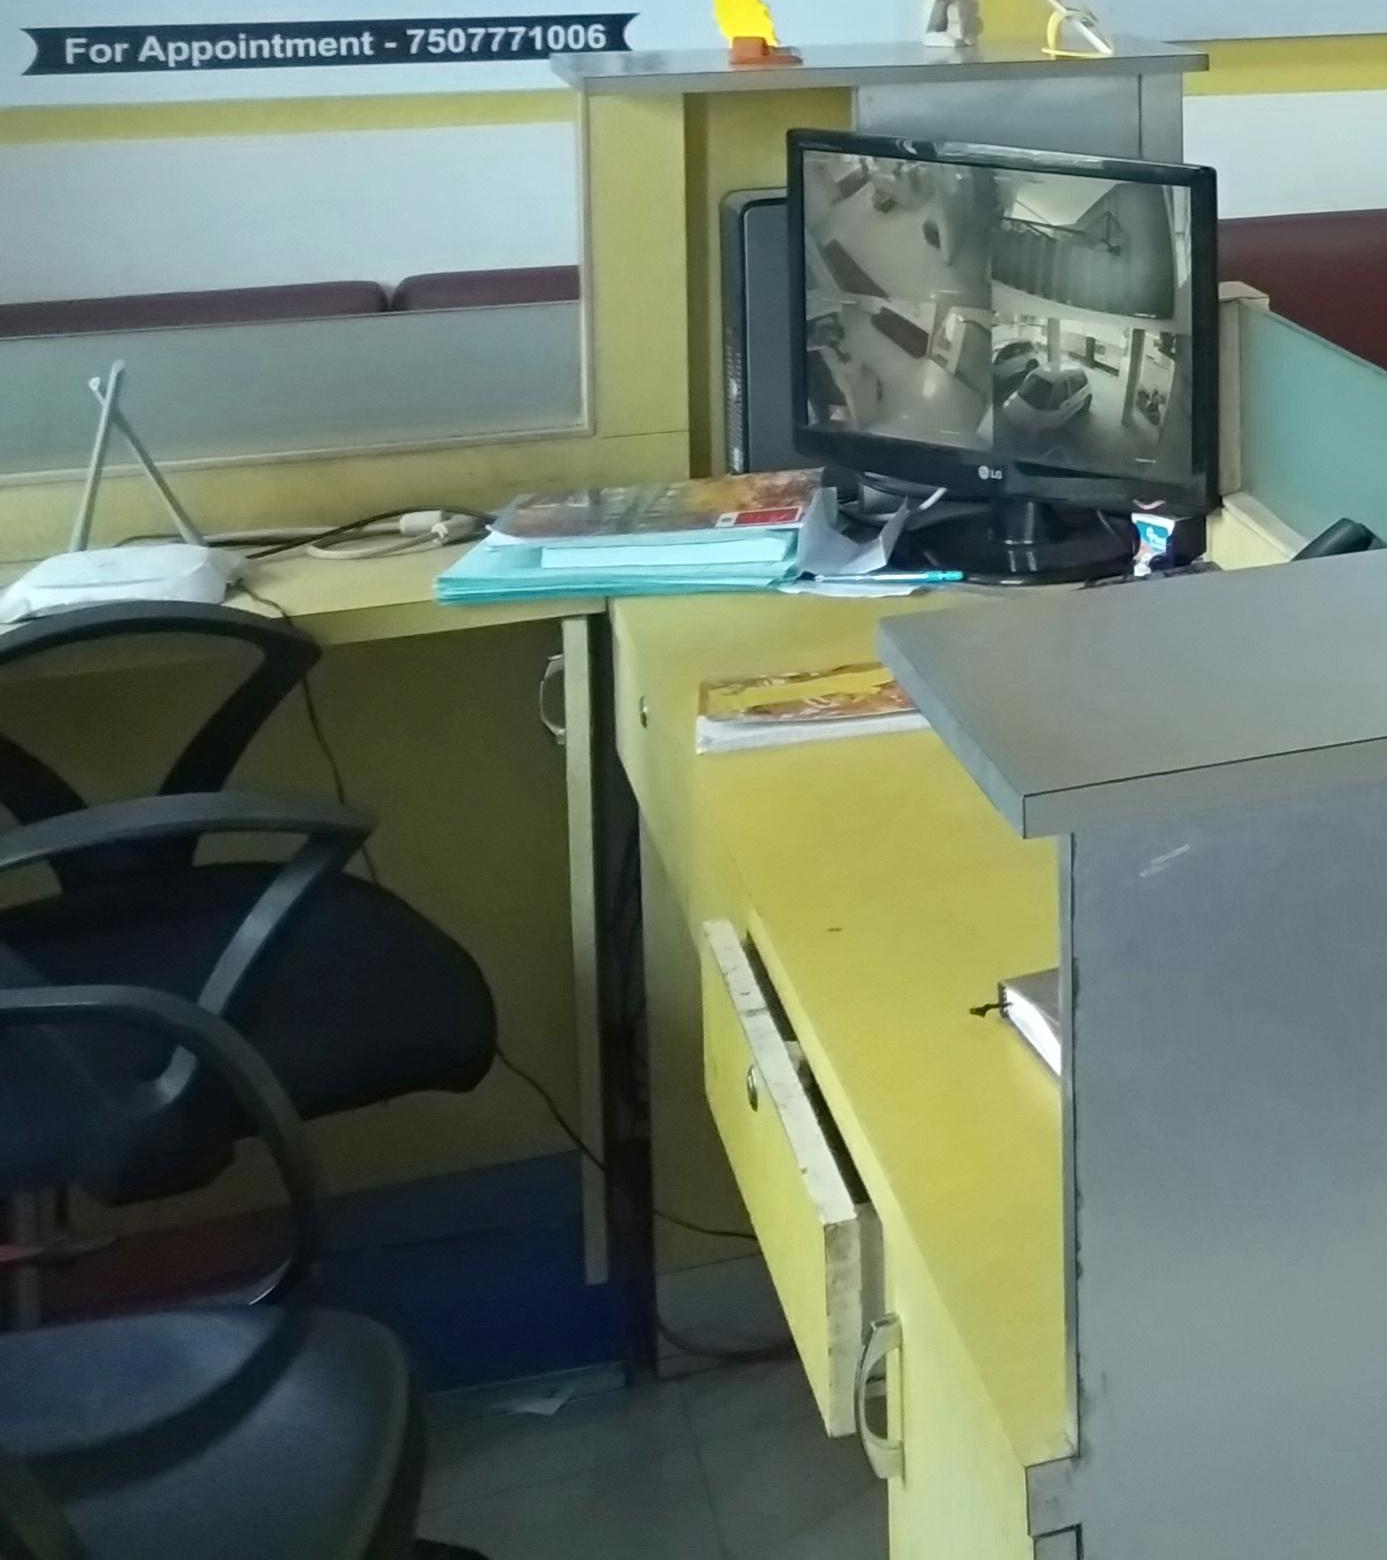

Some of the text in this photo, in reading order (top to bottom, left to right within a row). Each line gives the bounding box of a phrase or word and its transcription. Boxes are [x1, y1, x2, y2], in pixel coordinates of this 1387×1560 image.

[65, 23, 607, 68] For Appointment 7507771006
